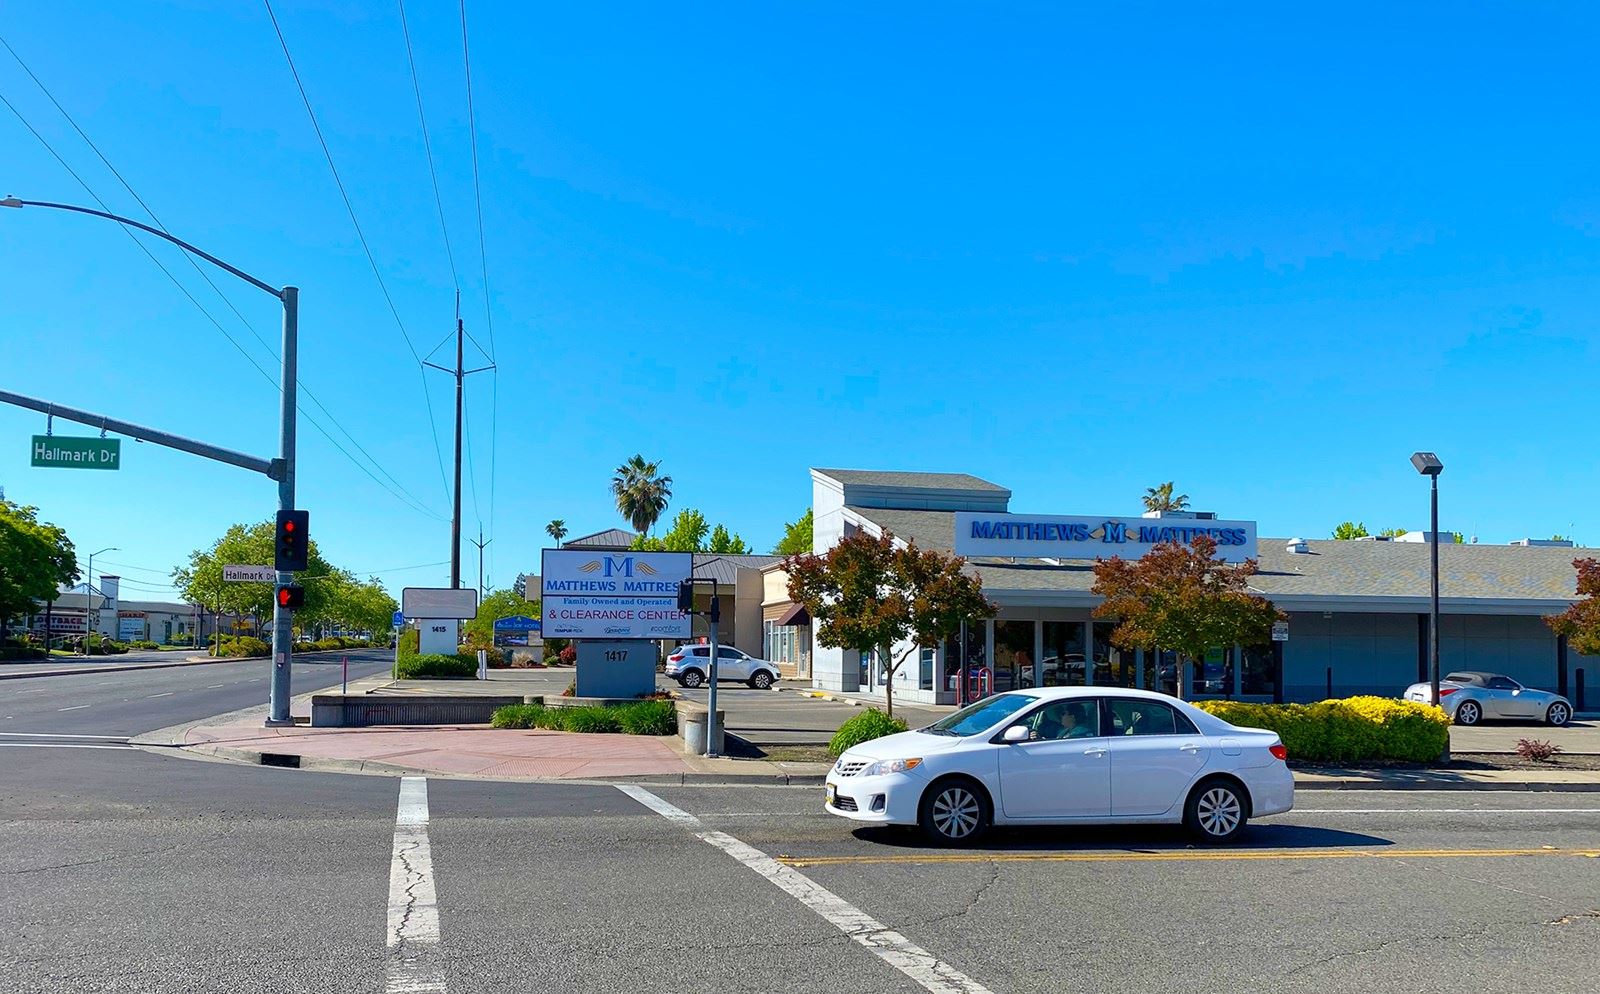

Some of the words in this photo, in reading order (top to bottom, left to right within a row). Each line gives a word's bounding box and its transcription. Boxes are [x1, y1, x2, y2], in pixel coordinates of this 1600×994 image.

[34, 442, 95, 462] Hallmark
[100, 449, 116, 462] Dr
[971, 520, 1090, 541] MATTHEWS
[1102, 521, 1127, 544] M
[603, 556, 634, 578] M
[225, 570, 263, 580] Hallmark
[546, 580, 616, 592] MATTHEWS
[623, 581, 679, 592] MATTRES
[563, 597, 589, 606] Family
[637, 598, 672, 606] Operated
[549, 609, 557, 619] &
[560, 609, 635, 620] CLEARANCE
[637, 610, 687, 620] CENTER
[604, 650, 628, 662] 1417
